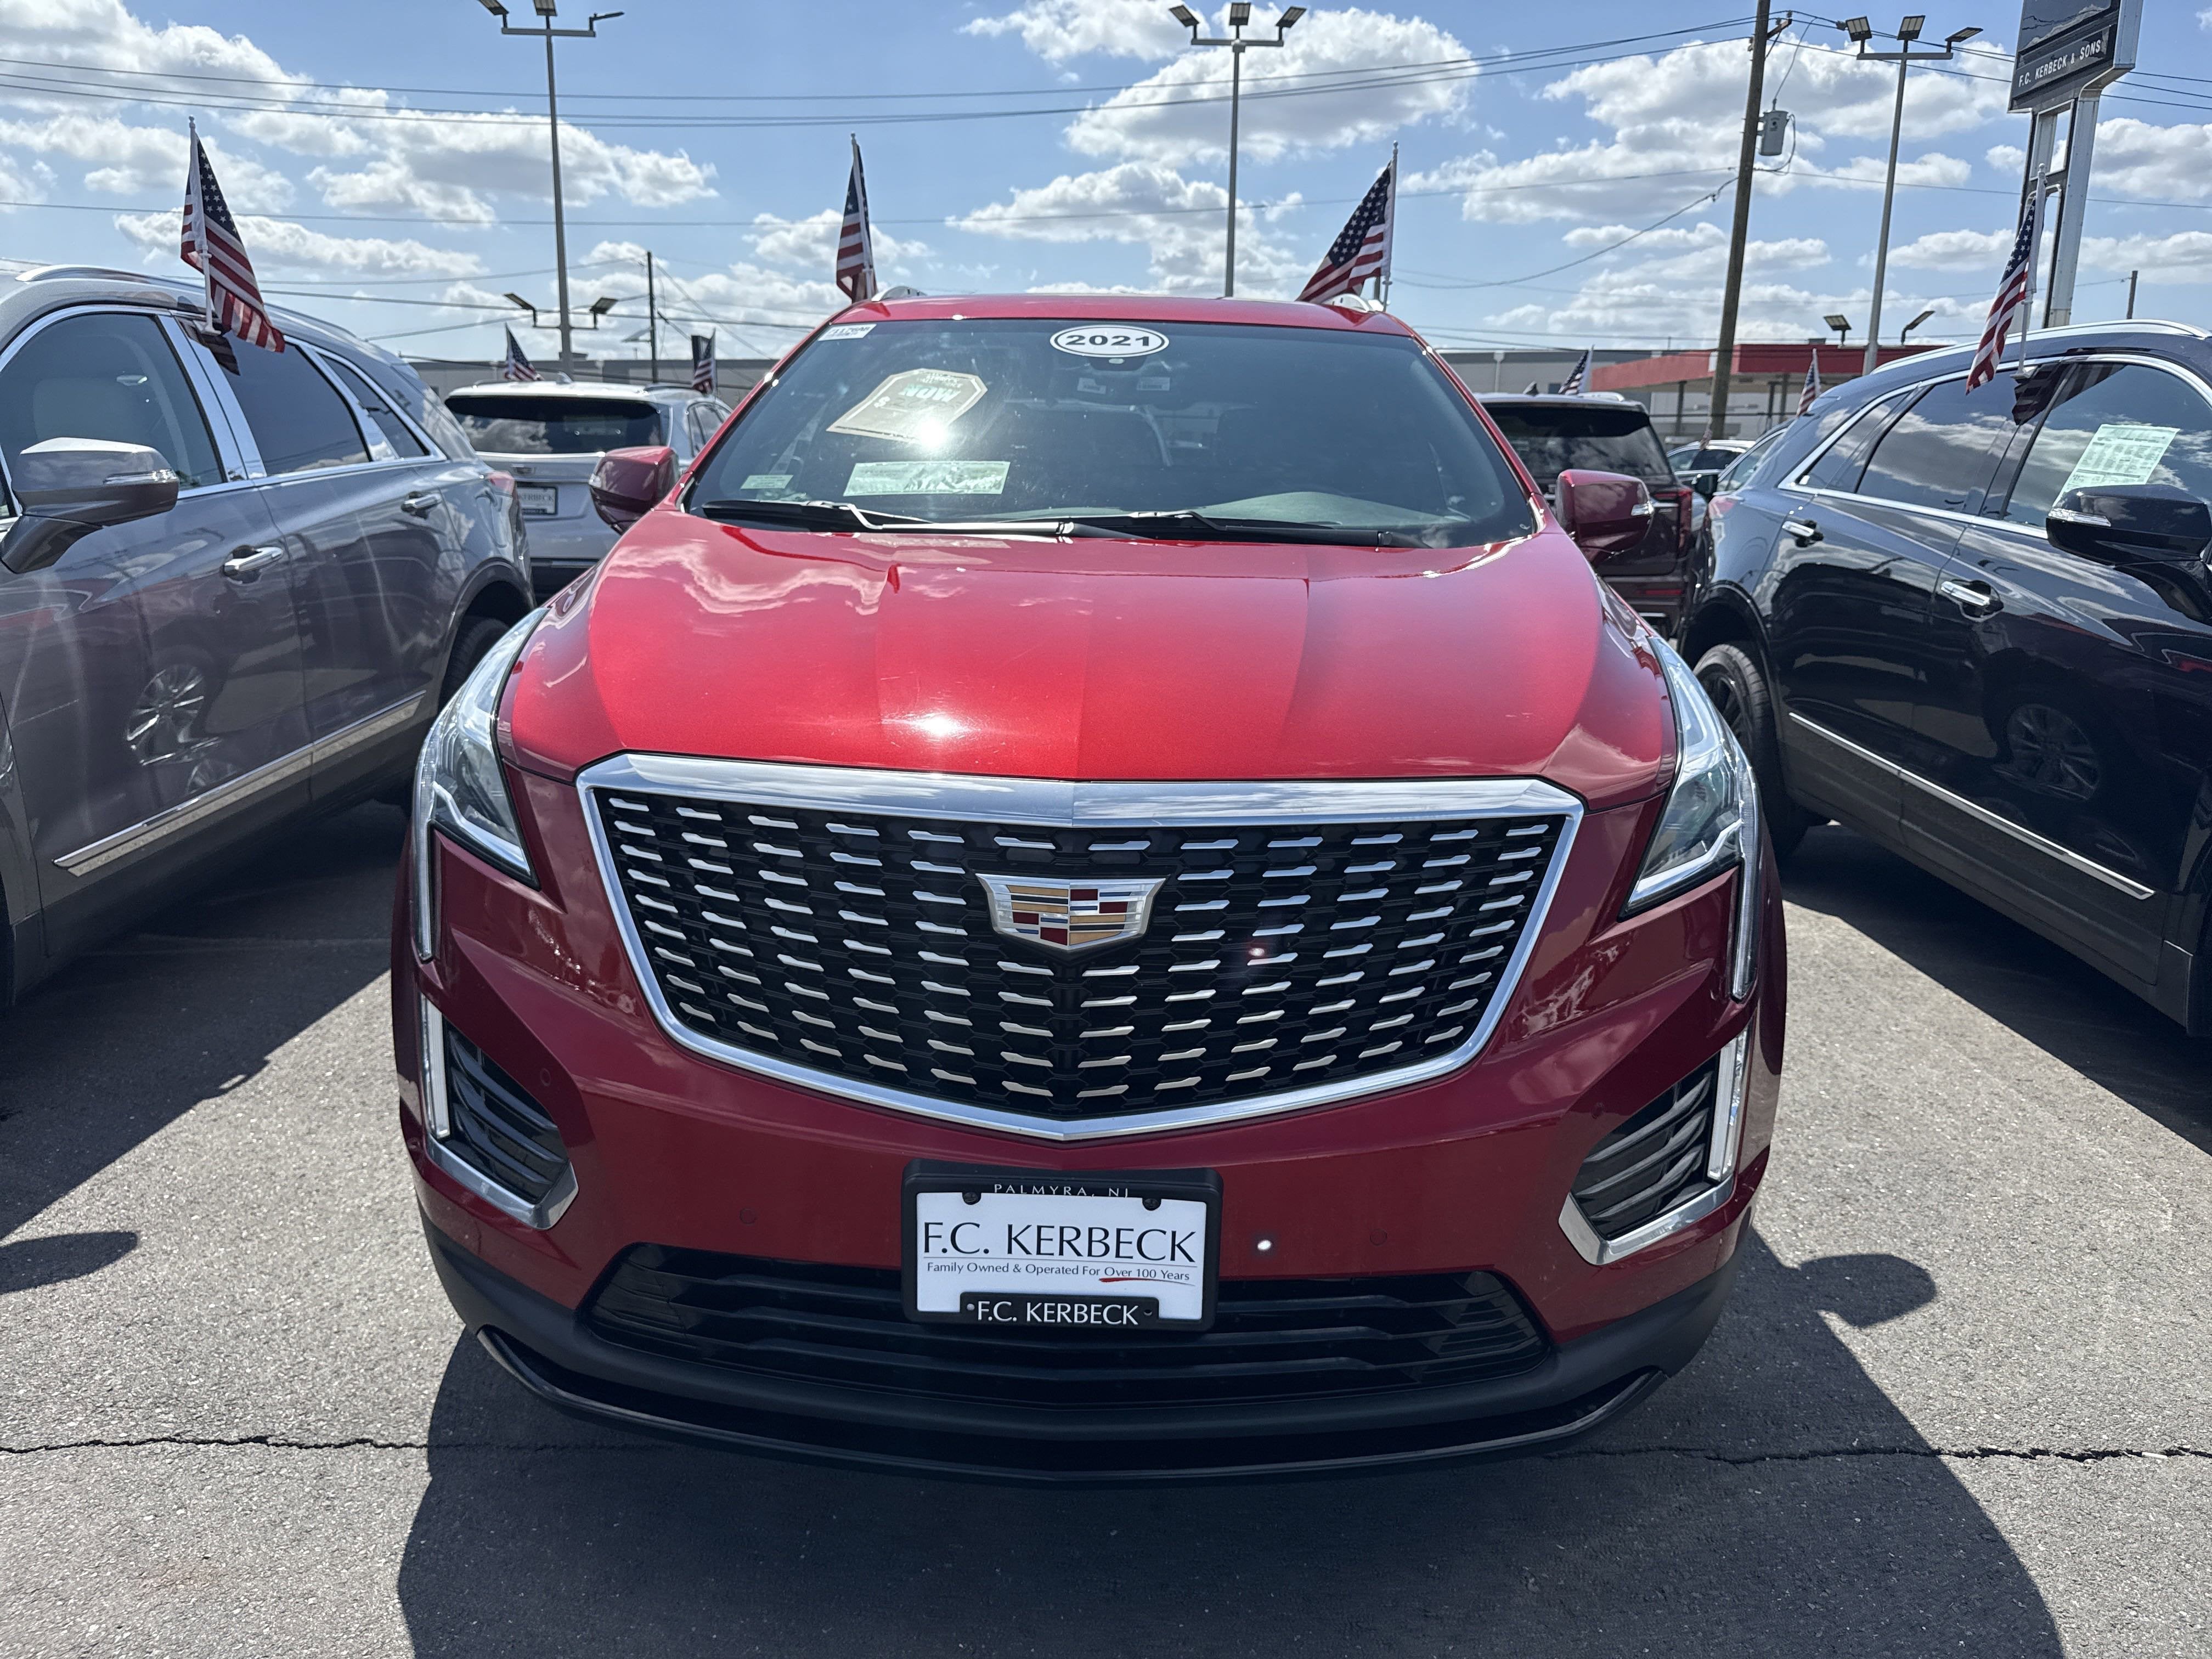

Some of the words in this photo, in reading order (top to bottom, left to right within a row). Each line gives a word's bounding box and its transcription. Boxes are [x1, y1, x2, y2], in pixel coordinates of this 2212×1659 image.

[2018, 72, 2032, 87] F.C.
[2035, 54, 2068, 80] KERBECK
[2070, 53, 2075, 64] &
[2079, 39, 2102, 60] SONS
[1065, 334, 1150, 347] 2021
[1108, 1187, 1128, 1198] NJ
[923, 1221, 990, 1255] F.C.
[1007, 1223, 1197, 1262] KERBECK
[927, 1262, 964, 1274] Family
[967, 1262, 1009, 1273] Owned
[1013, 1263, 1022, 1273] &
[1025, 1263, 1079, 1276] Operated
[1082, 1265, 1101, 1276] For
[1104, 1266, 1132, 1278] Over
[1136, 1268, 1157, 1279] 100
[1160, 1269, 1190, 1281] Years
[977, 1300, 1018, 1322] F.C.
[1026, 1301, 1139, 1326] KERBECK
